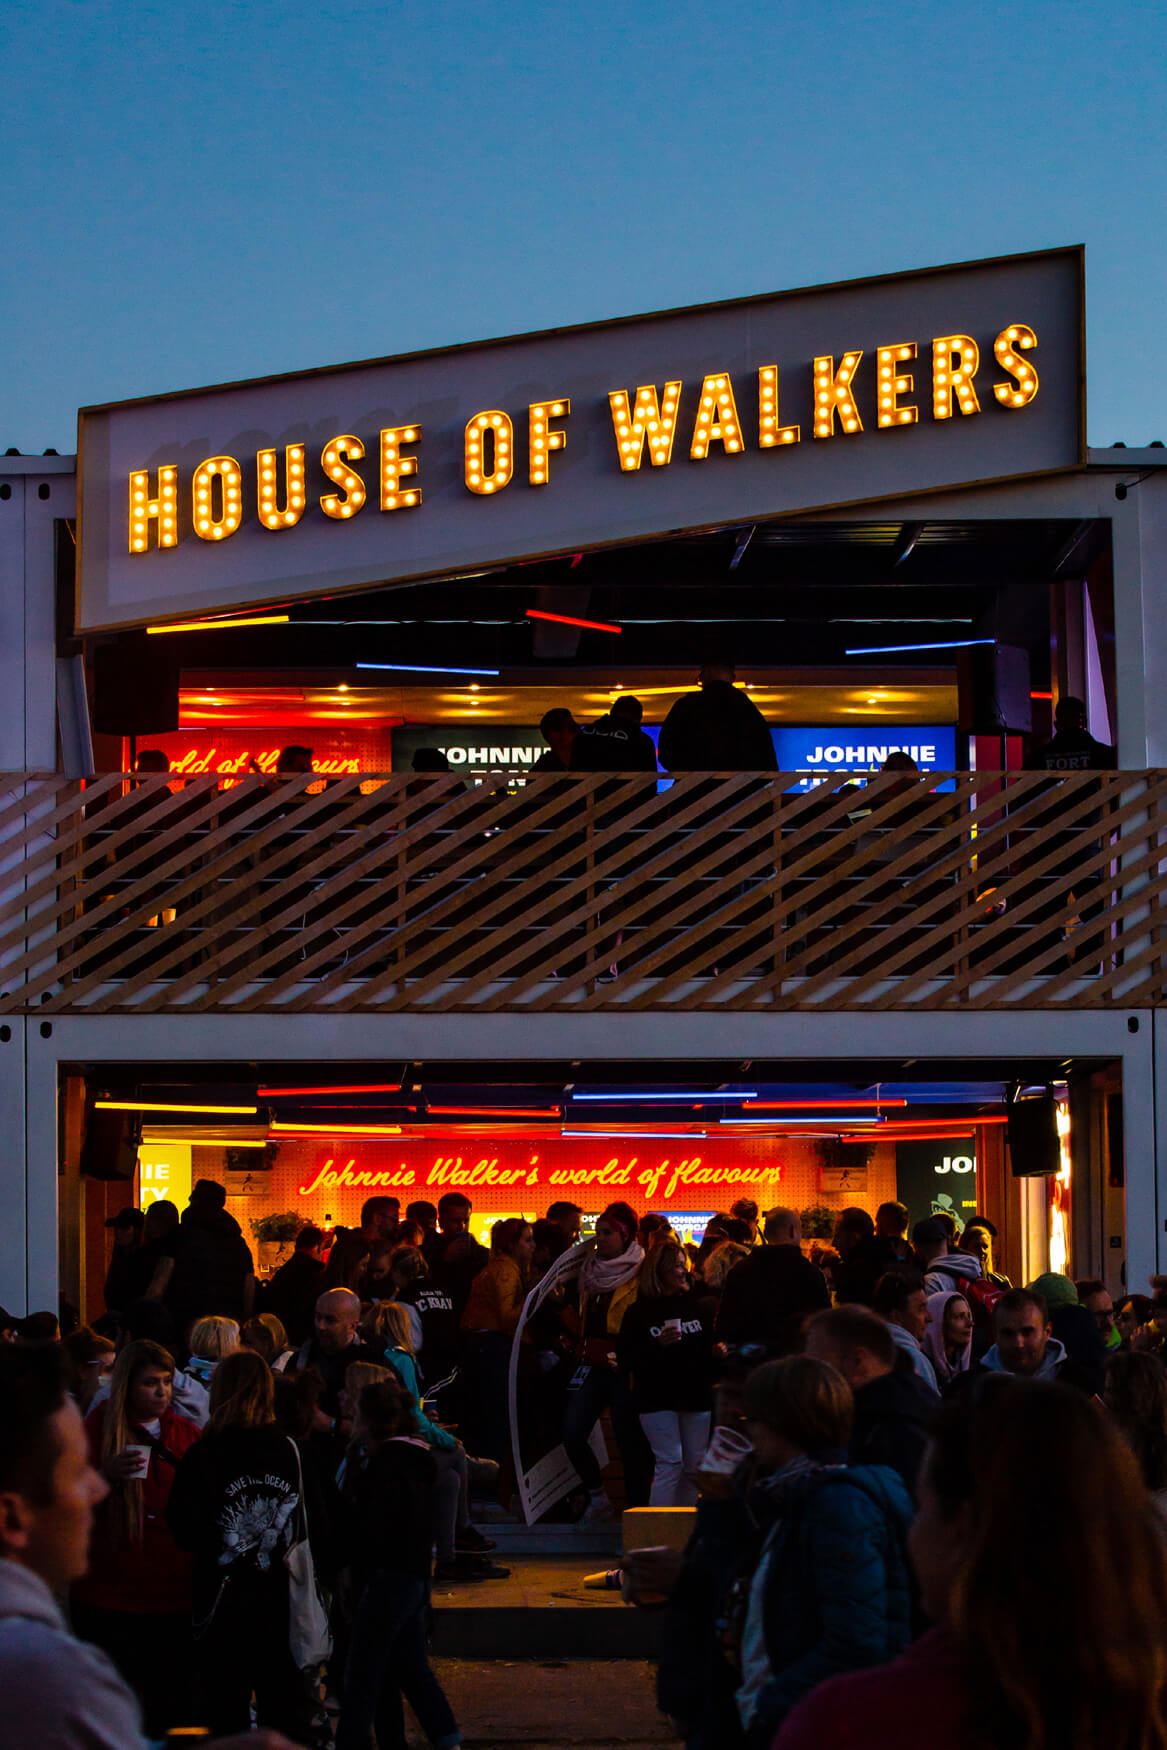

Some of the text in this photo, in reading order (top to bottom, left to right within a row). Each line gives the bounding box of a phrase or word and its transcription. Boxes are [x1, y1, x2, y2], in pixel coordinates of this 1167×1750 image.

[128, 323, 1040, 554] HOUSE OF WALKERS
[299, 1156, 781, 1199] Johnnie Walker's world of flavours
[225, 1476, 248, 1497] SAVE
[264, 1473, 292, 1494] OCEAN
